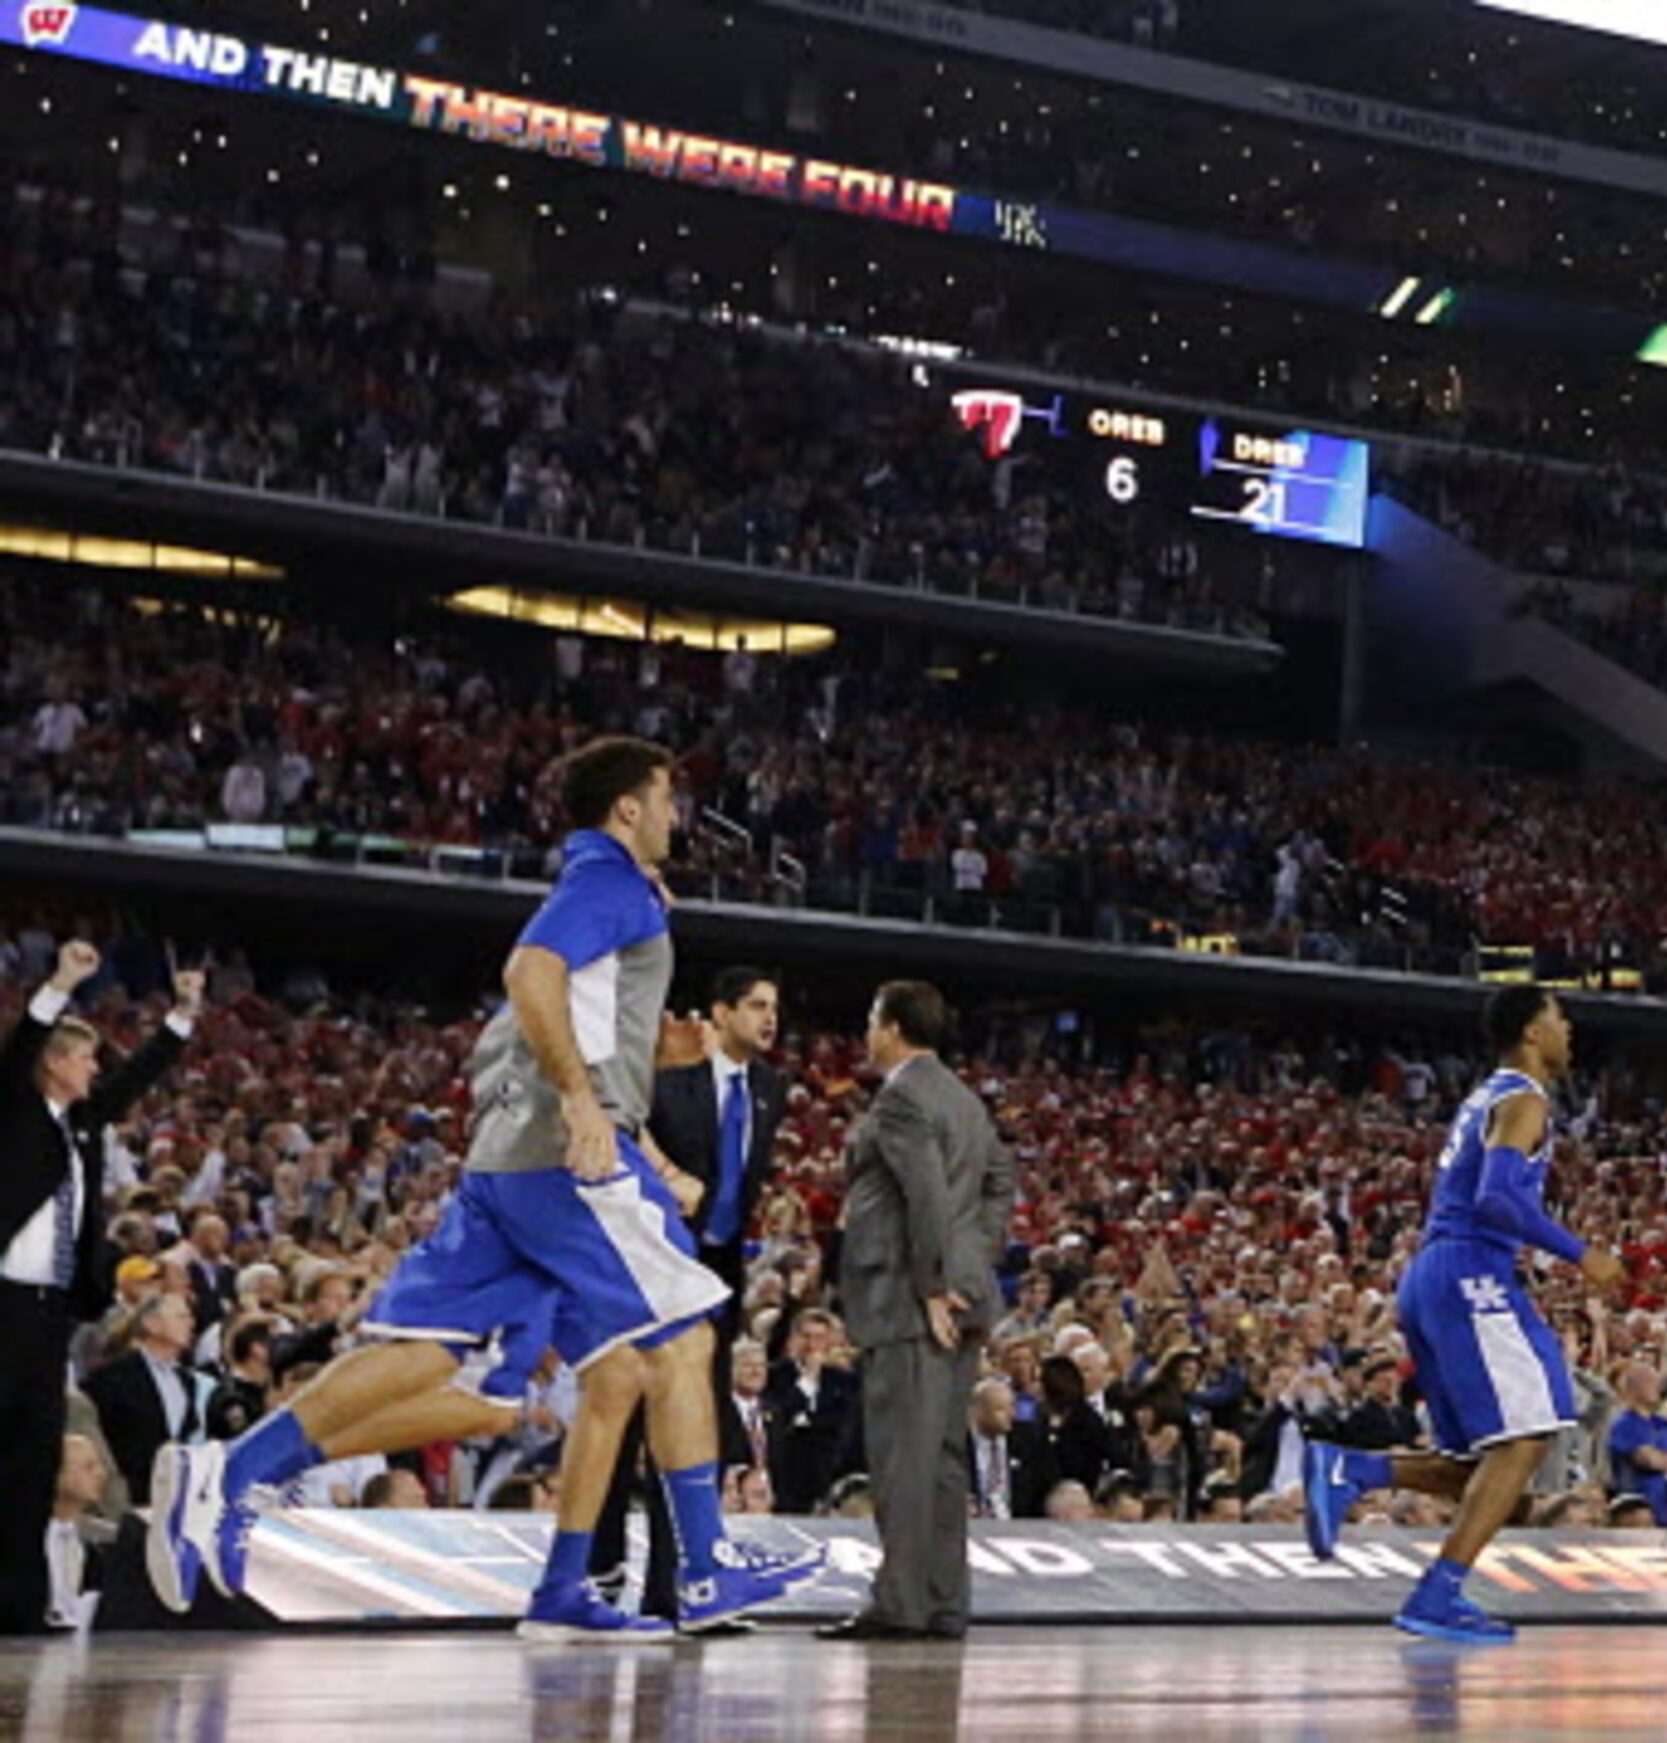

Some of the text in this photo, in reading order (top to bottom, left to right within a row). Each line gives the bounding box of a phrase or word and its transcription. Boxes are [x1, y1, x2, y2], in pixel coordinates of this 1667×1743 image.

[133, 22, 958, 231] AND THEN THERE WERE FOUR
[1303, 92, 1467, 146] TOM LANDRY
[1087, 408, 1306, 469] OREB DREB
[1106, 455, 1287, 525] 6 21
[1099, 1539, 1428, 1580] THEN
